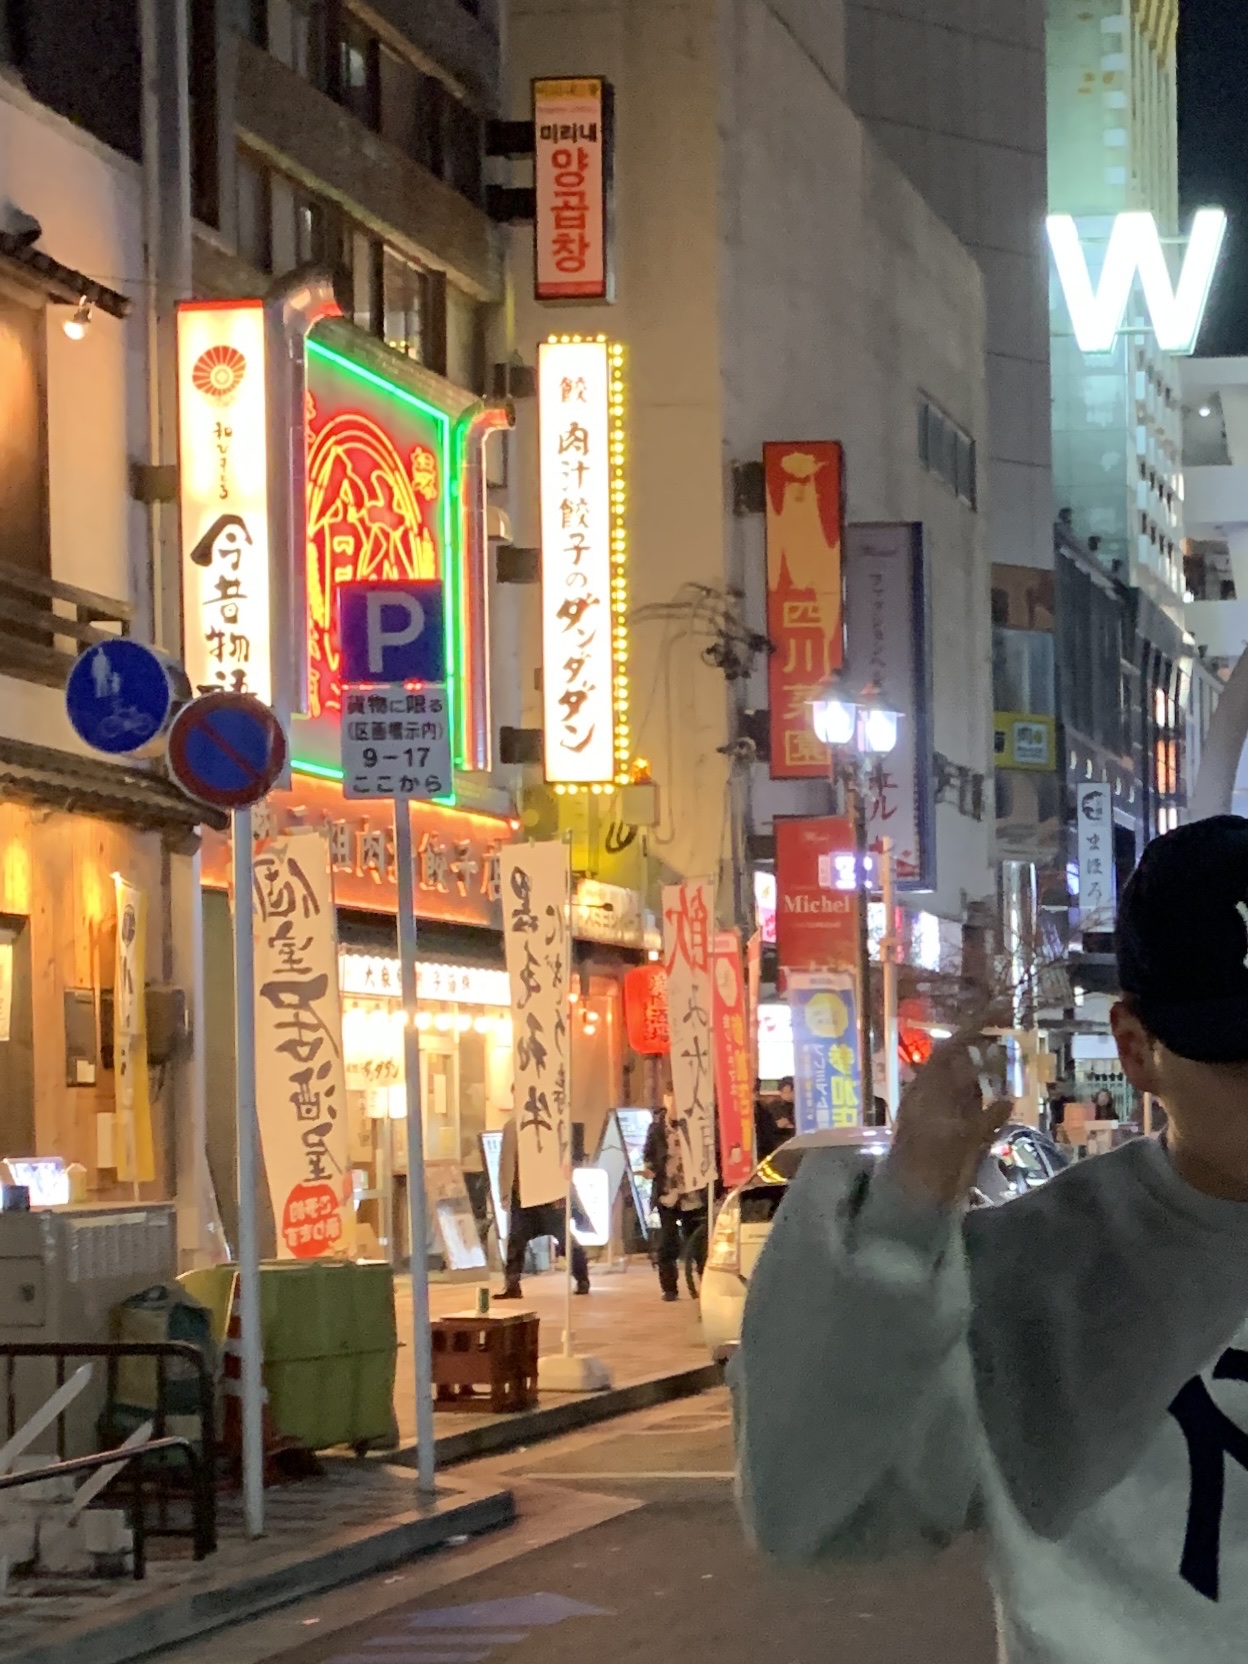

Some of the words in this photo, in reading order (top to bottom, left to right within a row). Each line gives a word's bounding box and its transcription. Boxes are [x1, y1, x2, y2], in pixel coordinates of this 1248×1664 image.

[540, 122, 598, 144] 미리내
[551, 147, 590, 273] 양곱창
[1046, 208, 1228, 356] W
[556, 421, 600, 753] 肉汁餃子のダンダダン
[366, 590, 425, 673] P
[346, 694, 443, 715] 貨物に限る
[352, 775, 442, 793] ここから
[784, 895, 850, 913] Michel
